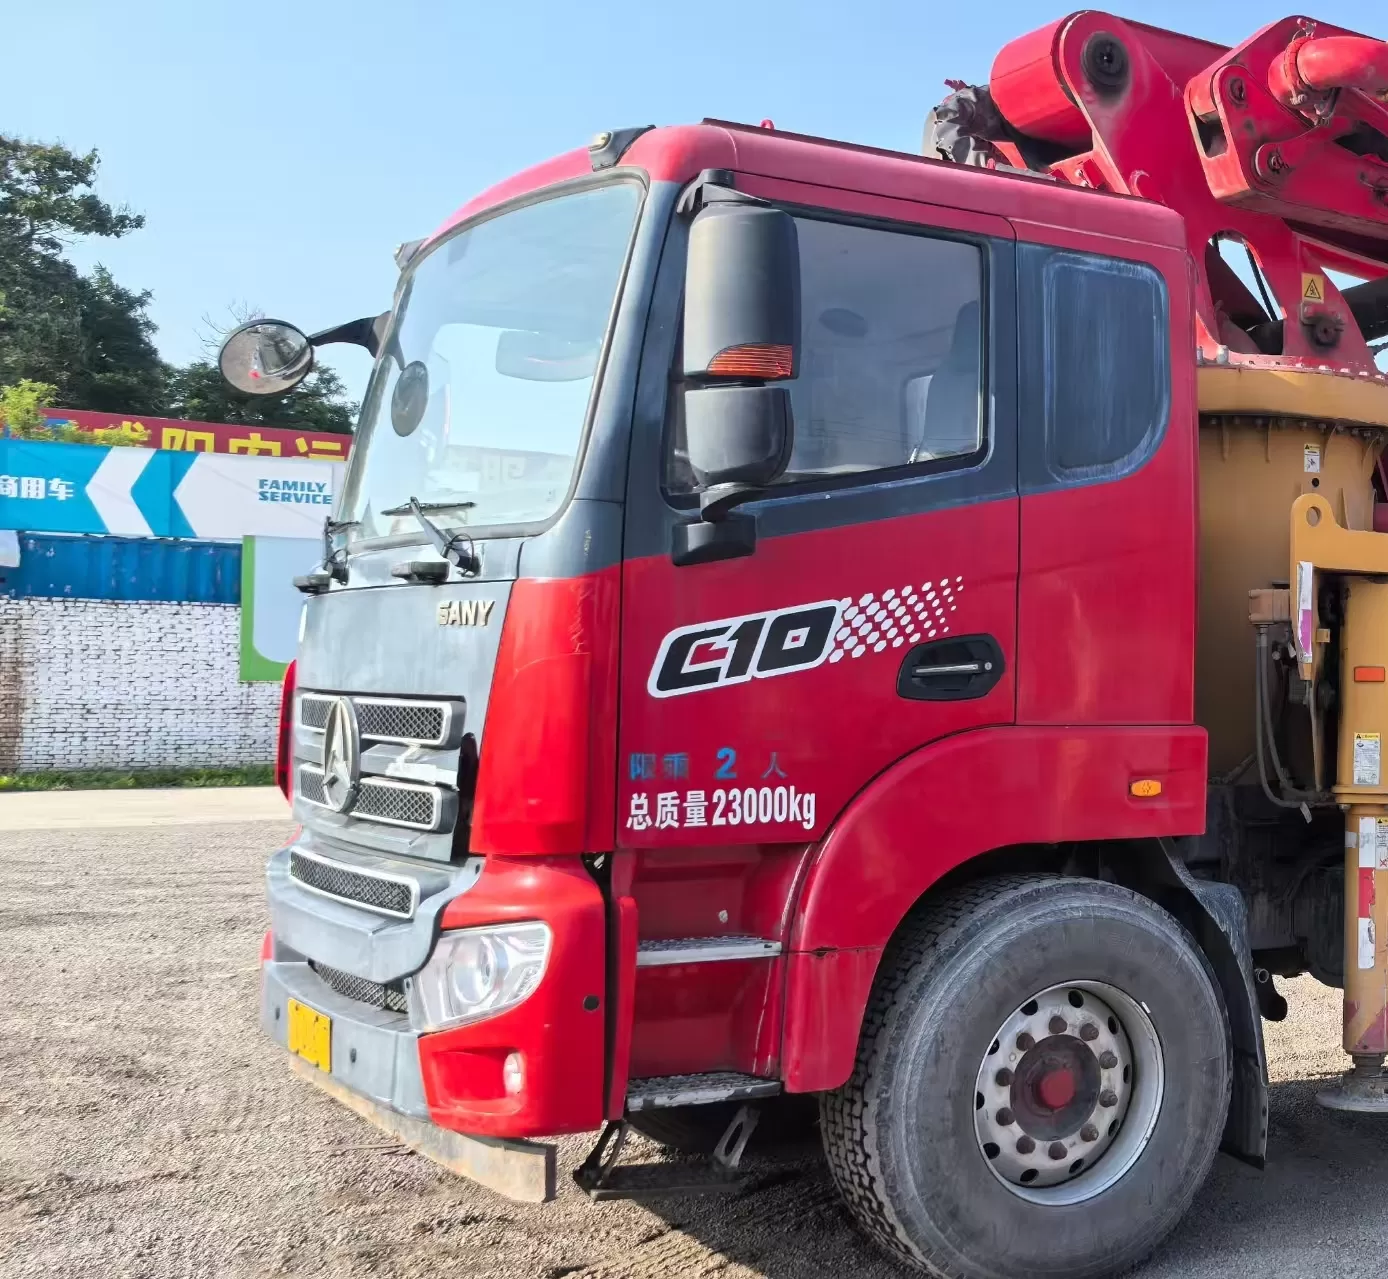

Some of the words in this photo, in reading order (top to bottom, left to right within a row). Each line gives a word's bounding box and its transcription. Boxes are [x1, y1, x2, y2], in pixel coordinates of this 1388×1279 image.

[258, 478, 327, 493] FAMILY
[258, 490, 332, 505] SERVICE
[439, 600, 496, 626] SANY
[648, 600, 841, 697] C10
[713, 747, 737, 780] 2
[760, 751, 788, 780] 人
[626, 785, 816, 830] 总质量23000kg
